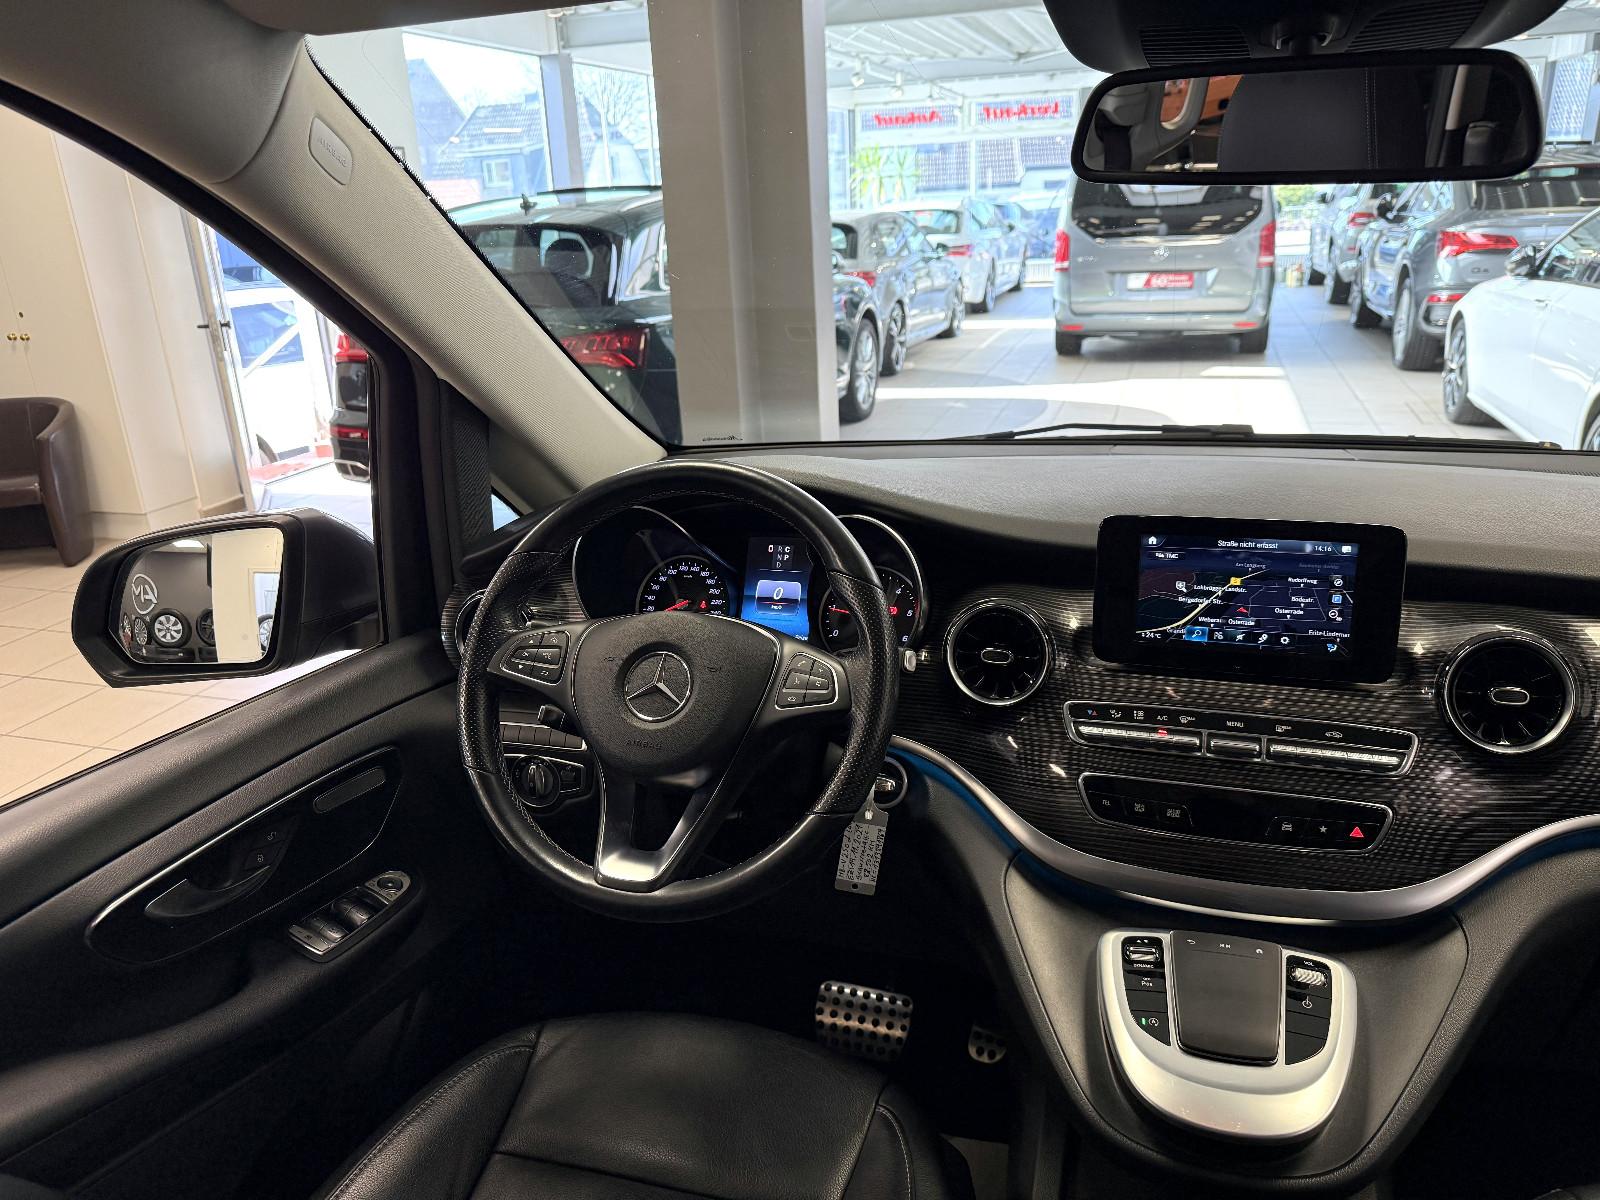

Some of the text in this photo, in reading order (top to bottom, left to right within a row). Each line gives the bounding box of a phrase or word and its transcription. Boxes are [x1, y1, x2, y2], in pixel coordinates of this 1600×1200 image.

[1218, 540, 1238, 548] Straße
[1257, 541, 1278, 549] erfasst
[773, 587, 784, 600] 0
[906, 609, 913, 617] 5
[832, 629, 839, 637] 0
